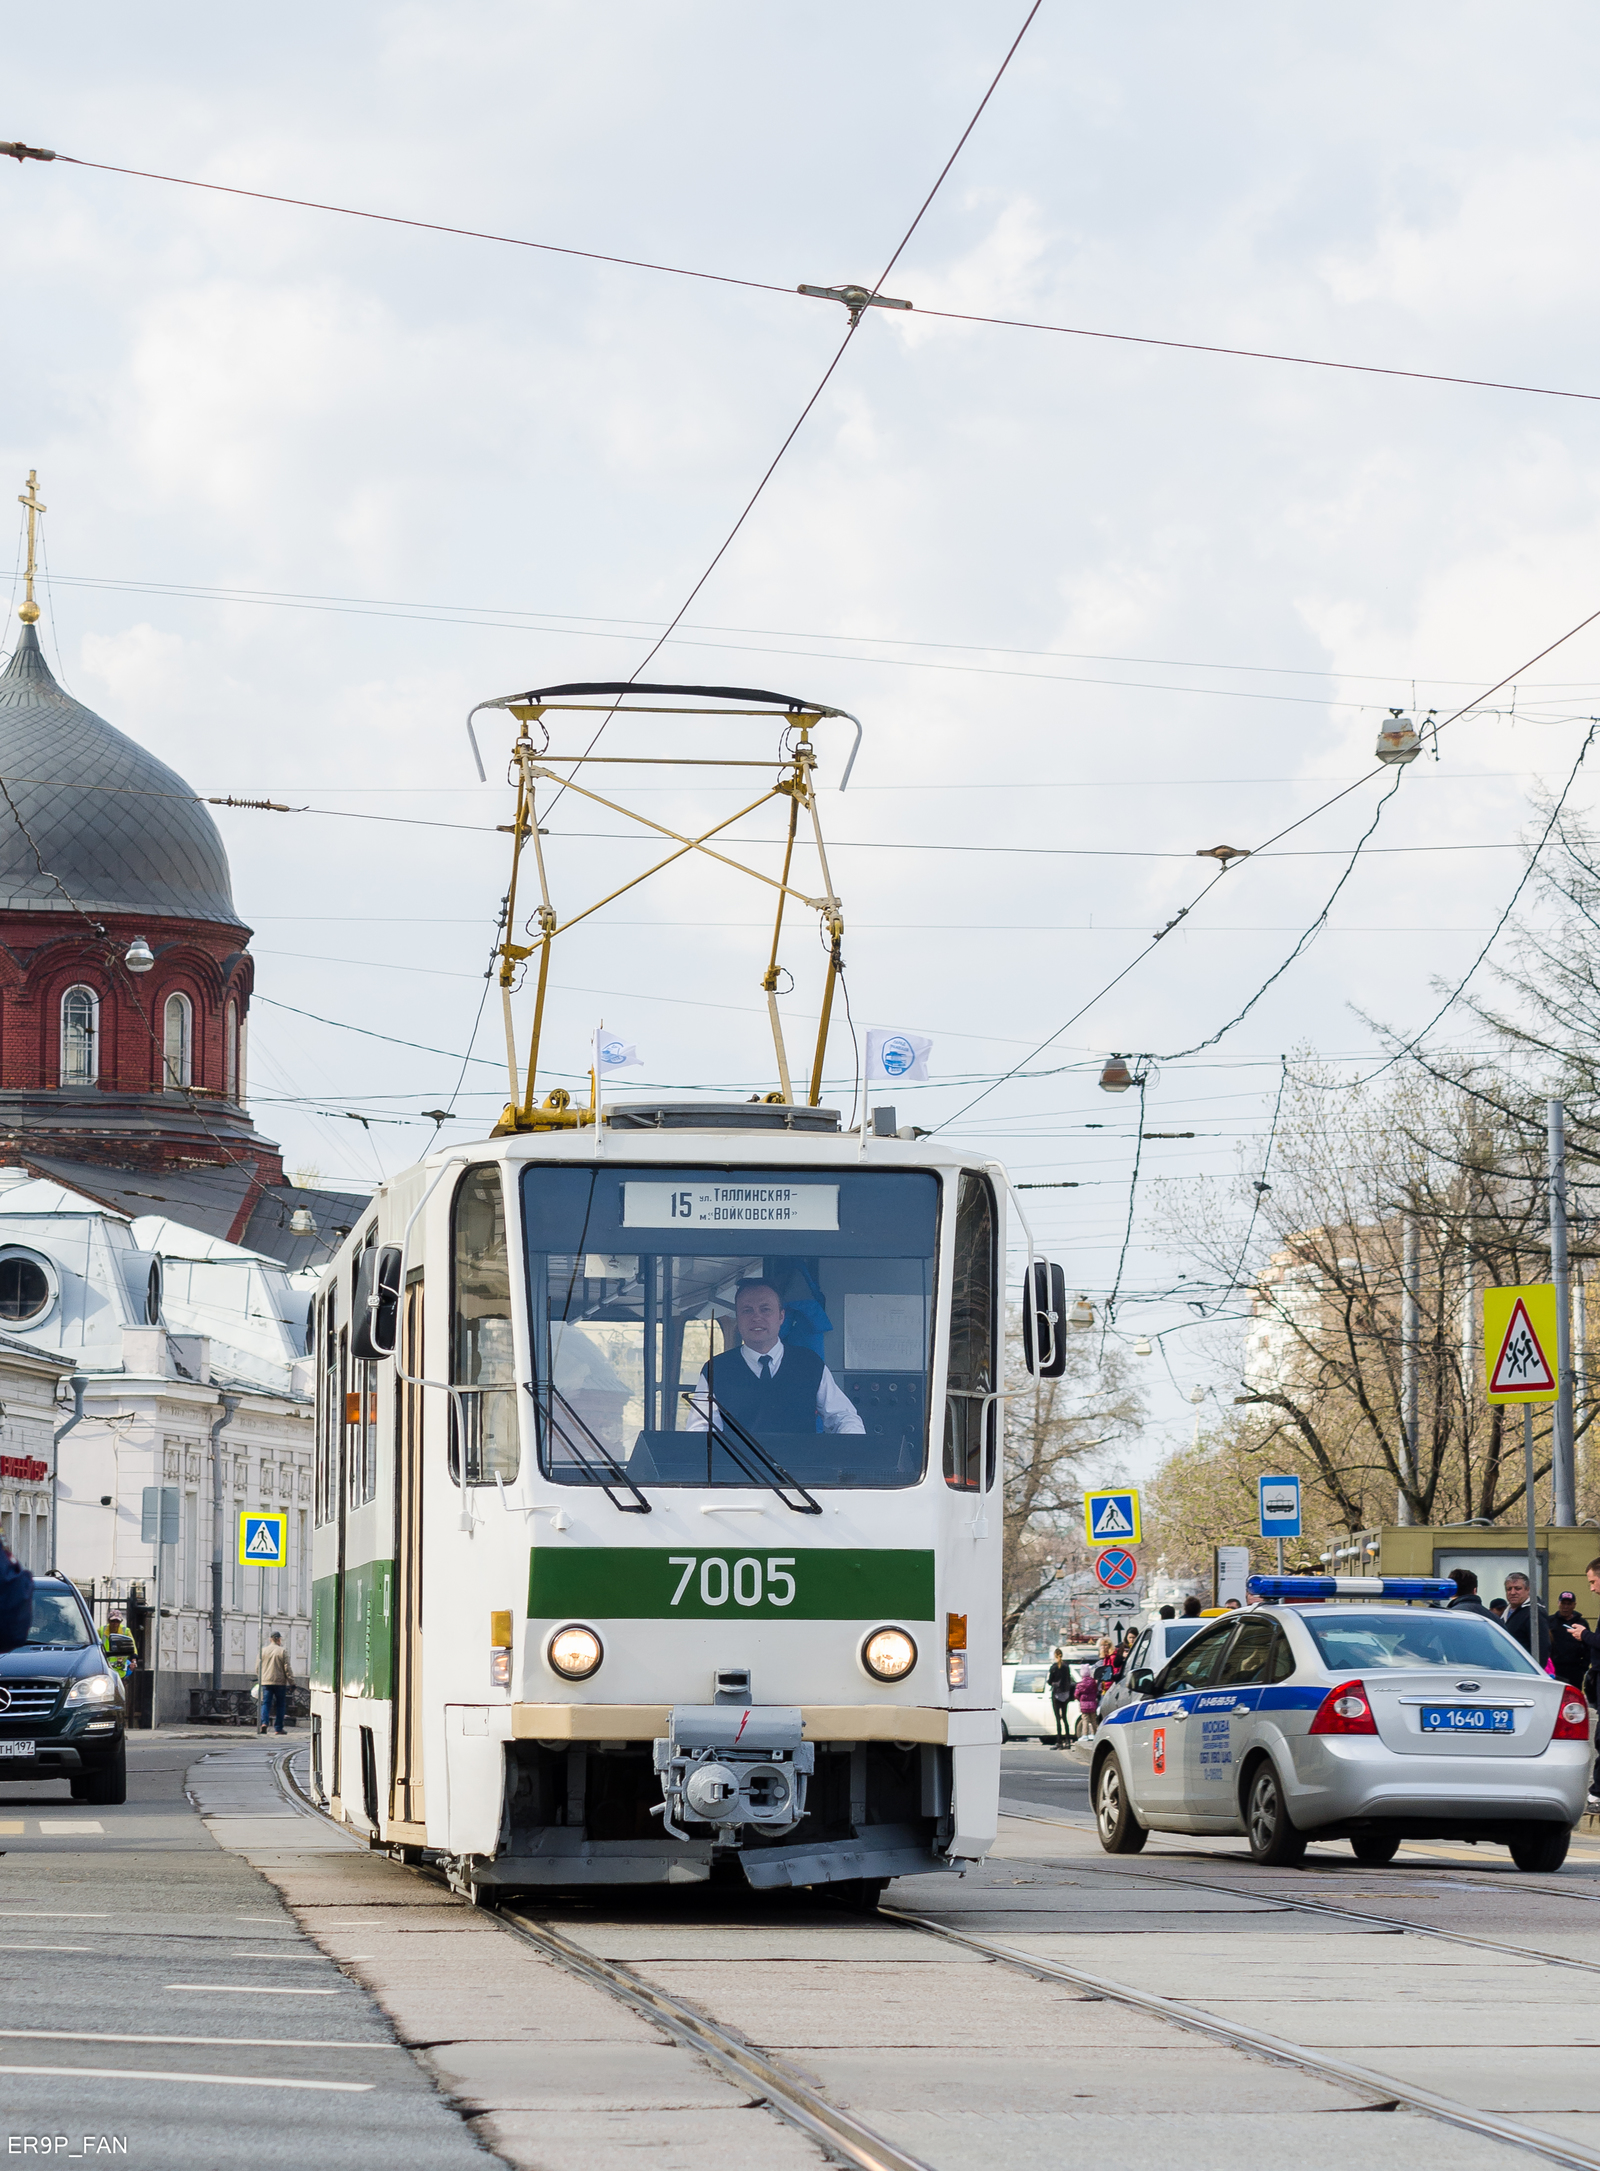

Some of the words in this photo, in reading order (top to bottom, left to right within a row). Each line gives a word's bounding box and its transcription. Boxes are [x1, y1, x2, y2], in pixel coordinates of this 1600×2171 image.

[671, 1192, 692, 1217] 15
[668, 1556, 796, 1607] 7005
[1446, 1710, 1485, 1726] 1640
[1492, 1711, 1509, 1723] 99
[1202, 1720, 1229, 1733] МОСКВА
[15, 1741, 31, 1751] 197
